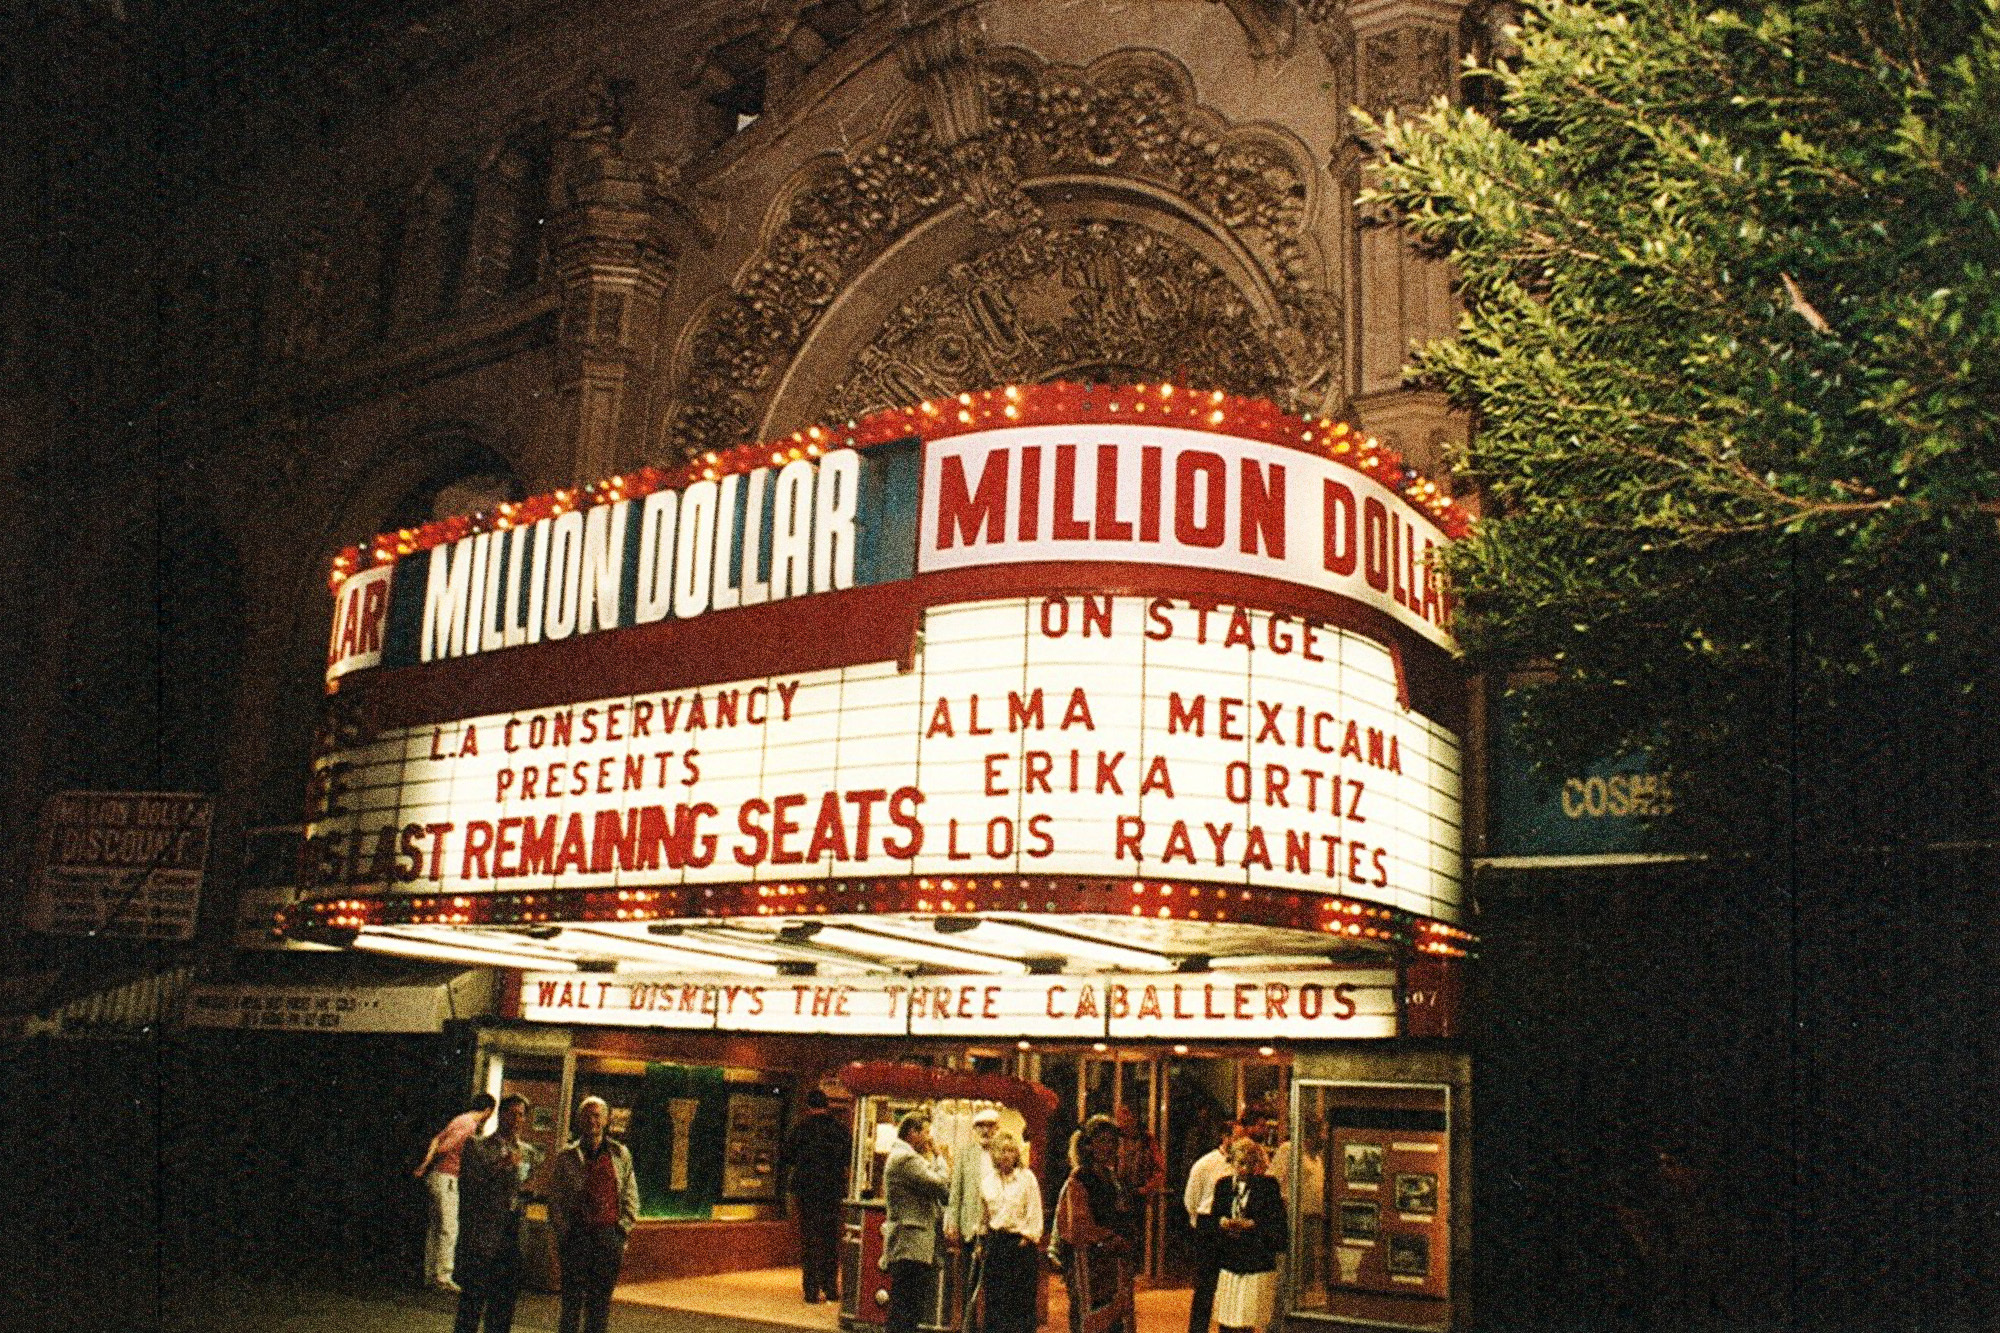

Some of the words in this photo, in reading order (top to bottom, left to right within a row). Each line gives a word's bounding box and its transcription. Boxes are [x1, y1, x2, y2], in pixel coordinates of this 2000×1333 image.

[936, 444, 1286, 561] MILLION
[421, 500, 628, 662] MILLION
[636, 448, 860, 625] DOLLAR
[1040, 596, 1113, 639] ON
[1144, 599, 1324, 662] STAGE
[504, 681, 800, 753] CONSERVANCY
[926, 687, 1095, 739] ALMA
[1168, 692, 1402, 776] MEXICANA
[496, 749, 701, 803] PRESENTS
[985, 750, 1174, 799] ERIKA
[1225, 761, 1366, 824] ORTIZ
[460, 802, 719, 880] REMAINING
[734, 786, 925, 868] SEATS
[948, 814, 1055, 861] LOS
[1115, 815, 1389, 888] RAYANTES
[538, 981, 612, 1009] WALT
[792, 984, 855, 1017] THE
[884, 985, 1001, 1018] THREE
[1046, 982, 1358, 1021] CABALLEROS
